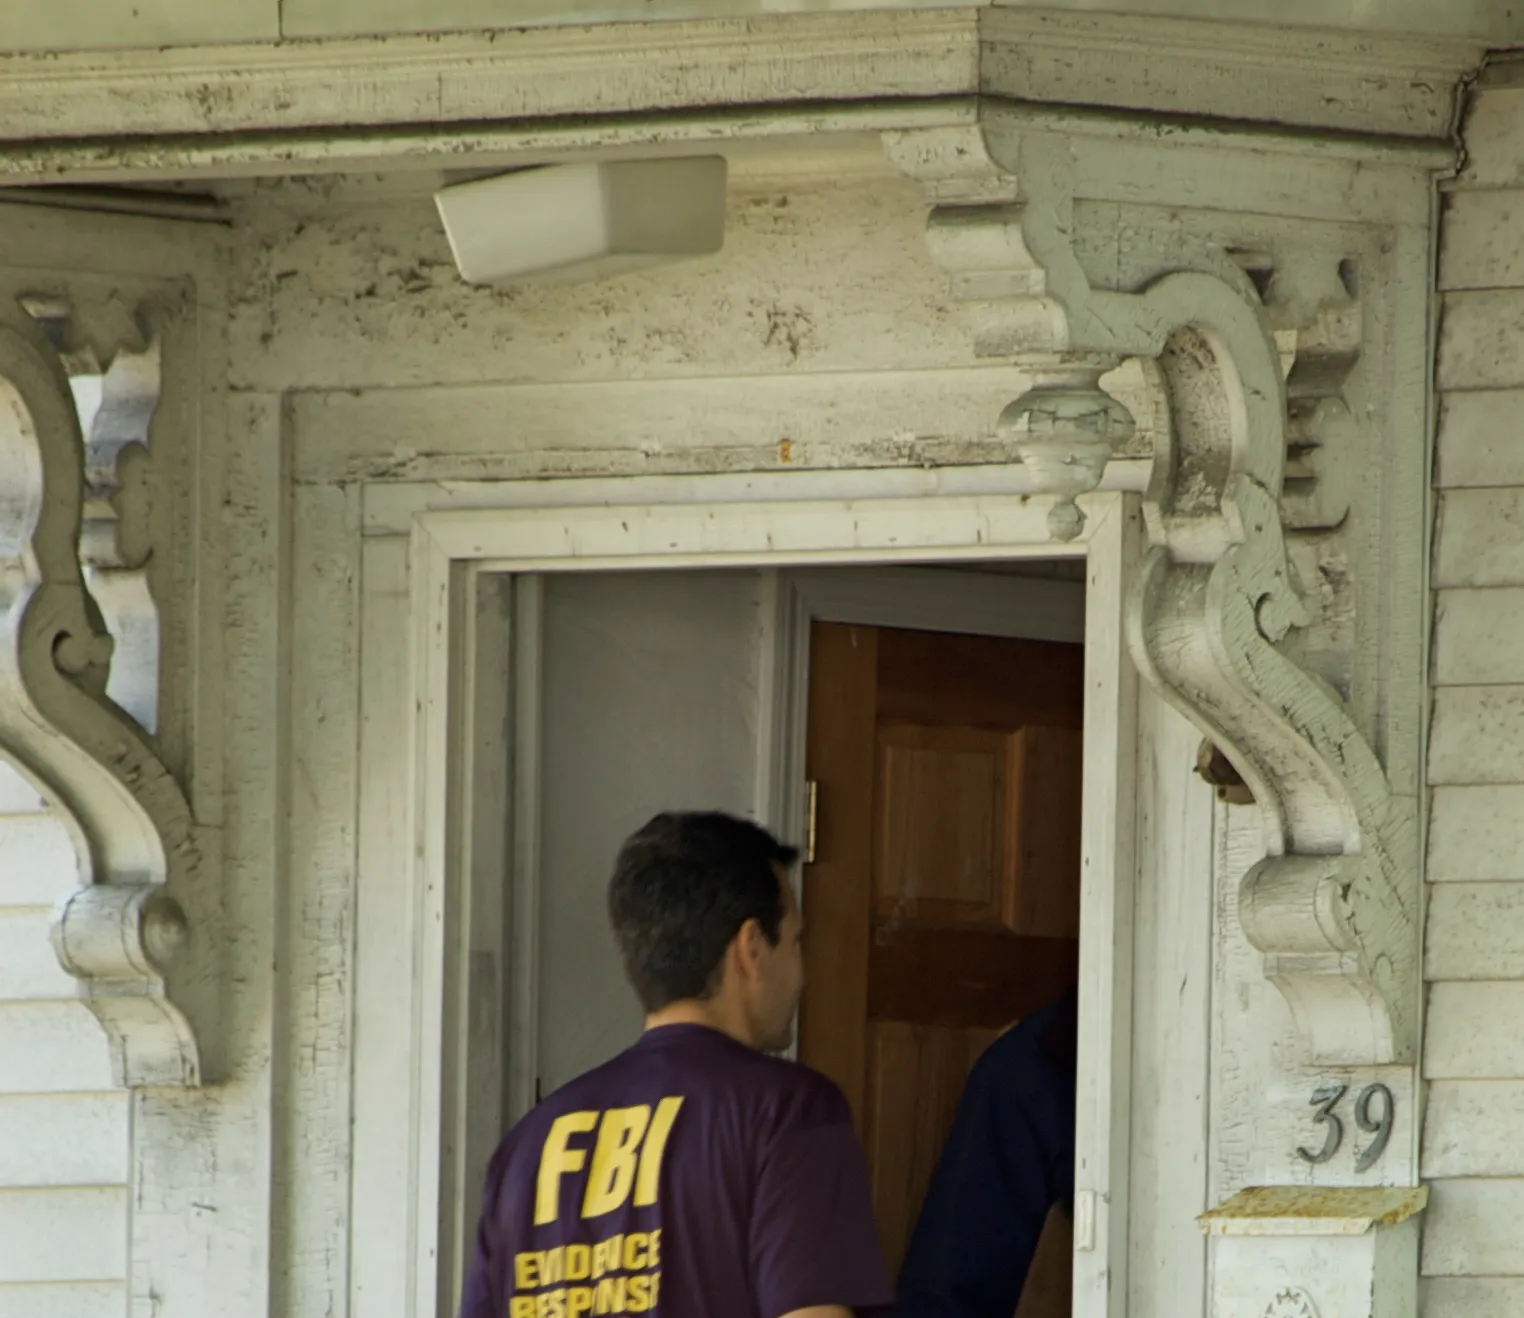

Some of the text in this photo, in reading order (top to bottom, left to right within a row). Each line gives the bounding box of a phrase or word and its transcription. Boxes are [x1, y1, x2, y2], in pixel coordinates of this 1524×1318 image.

[533, 1095, 685, 1226] FBI
[1297, 1082, 1395, 1174] 39
[514, 1228, 662, 1290] EVIDENCE
